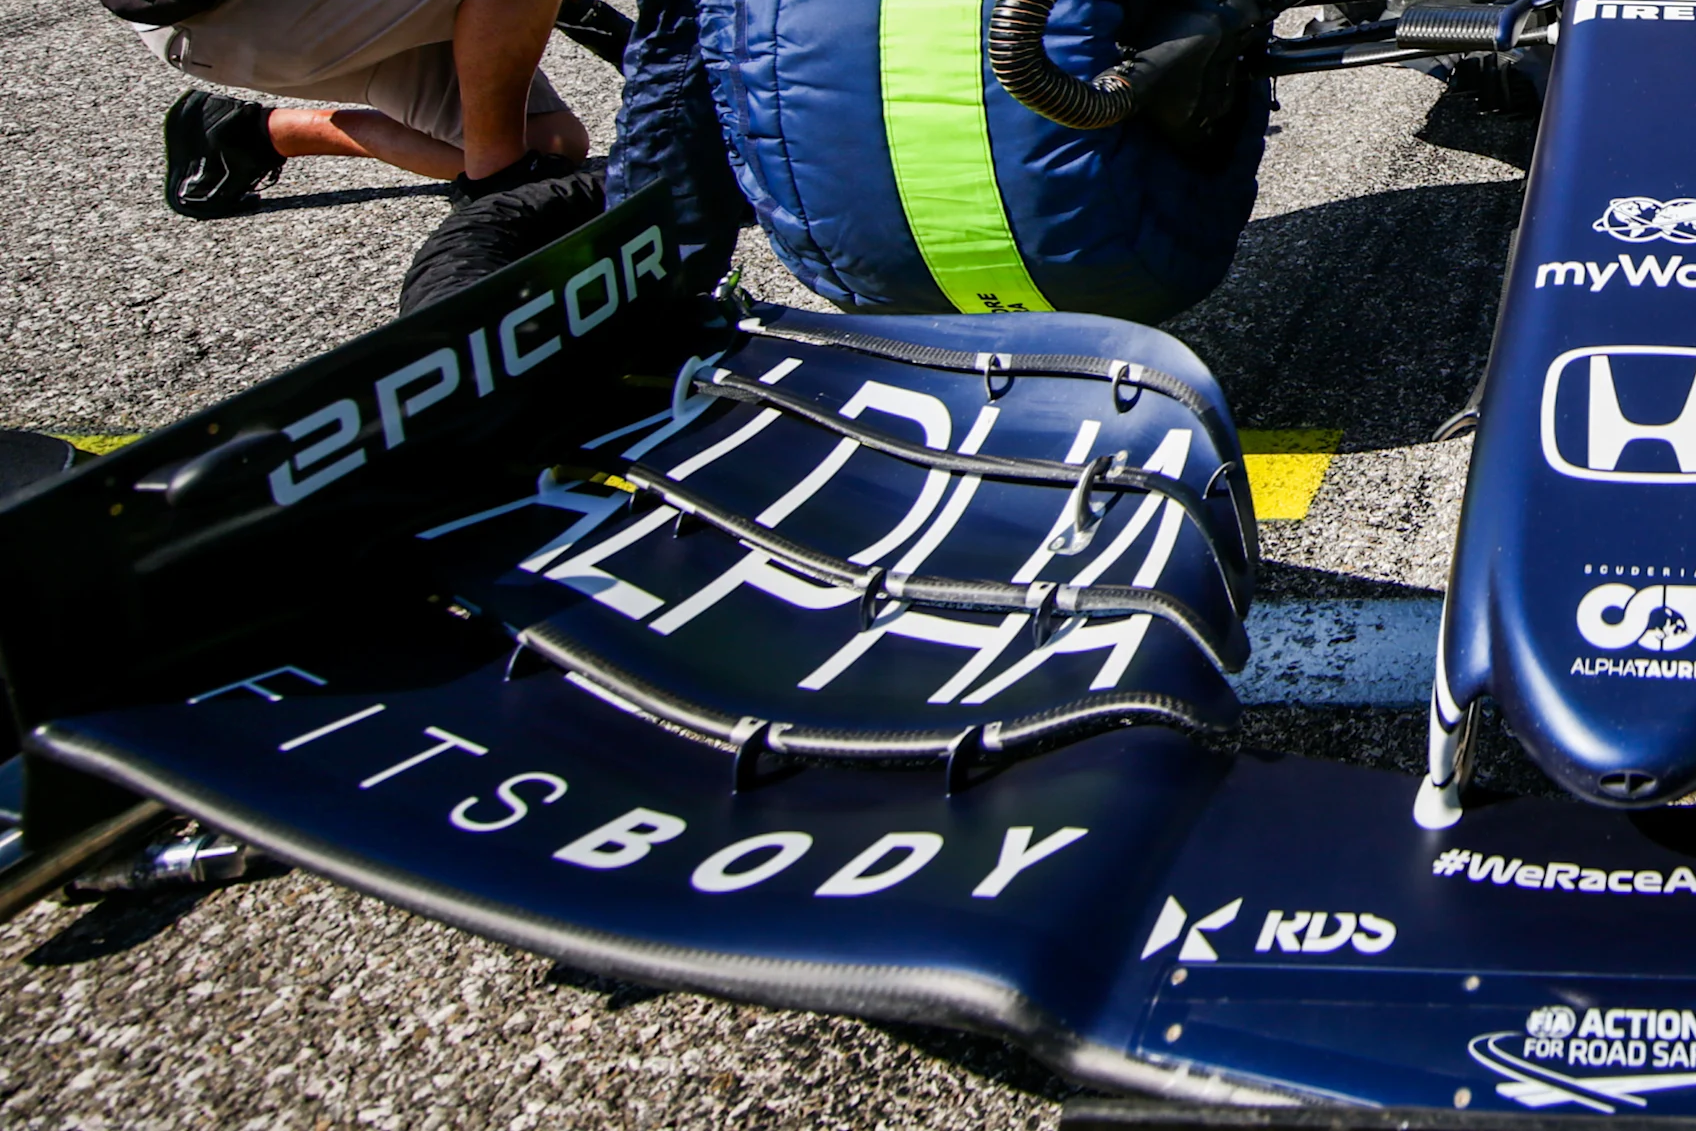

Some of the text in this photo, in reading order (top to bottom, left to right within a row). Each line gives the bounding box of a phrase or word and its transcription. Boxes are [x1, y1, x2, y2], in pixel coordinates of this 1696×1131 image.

[1528, 1010, 1575, 1036] FIA
[1523, 1037, 1565, 1059] FOR
[1567, 1038, 1648, 1068] ROAD
